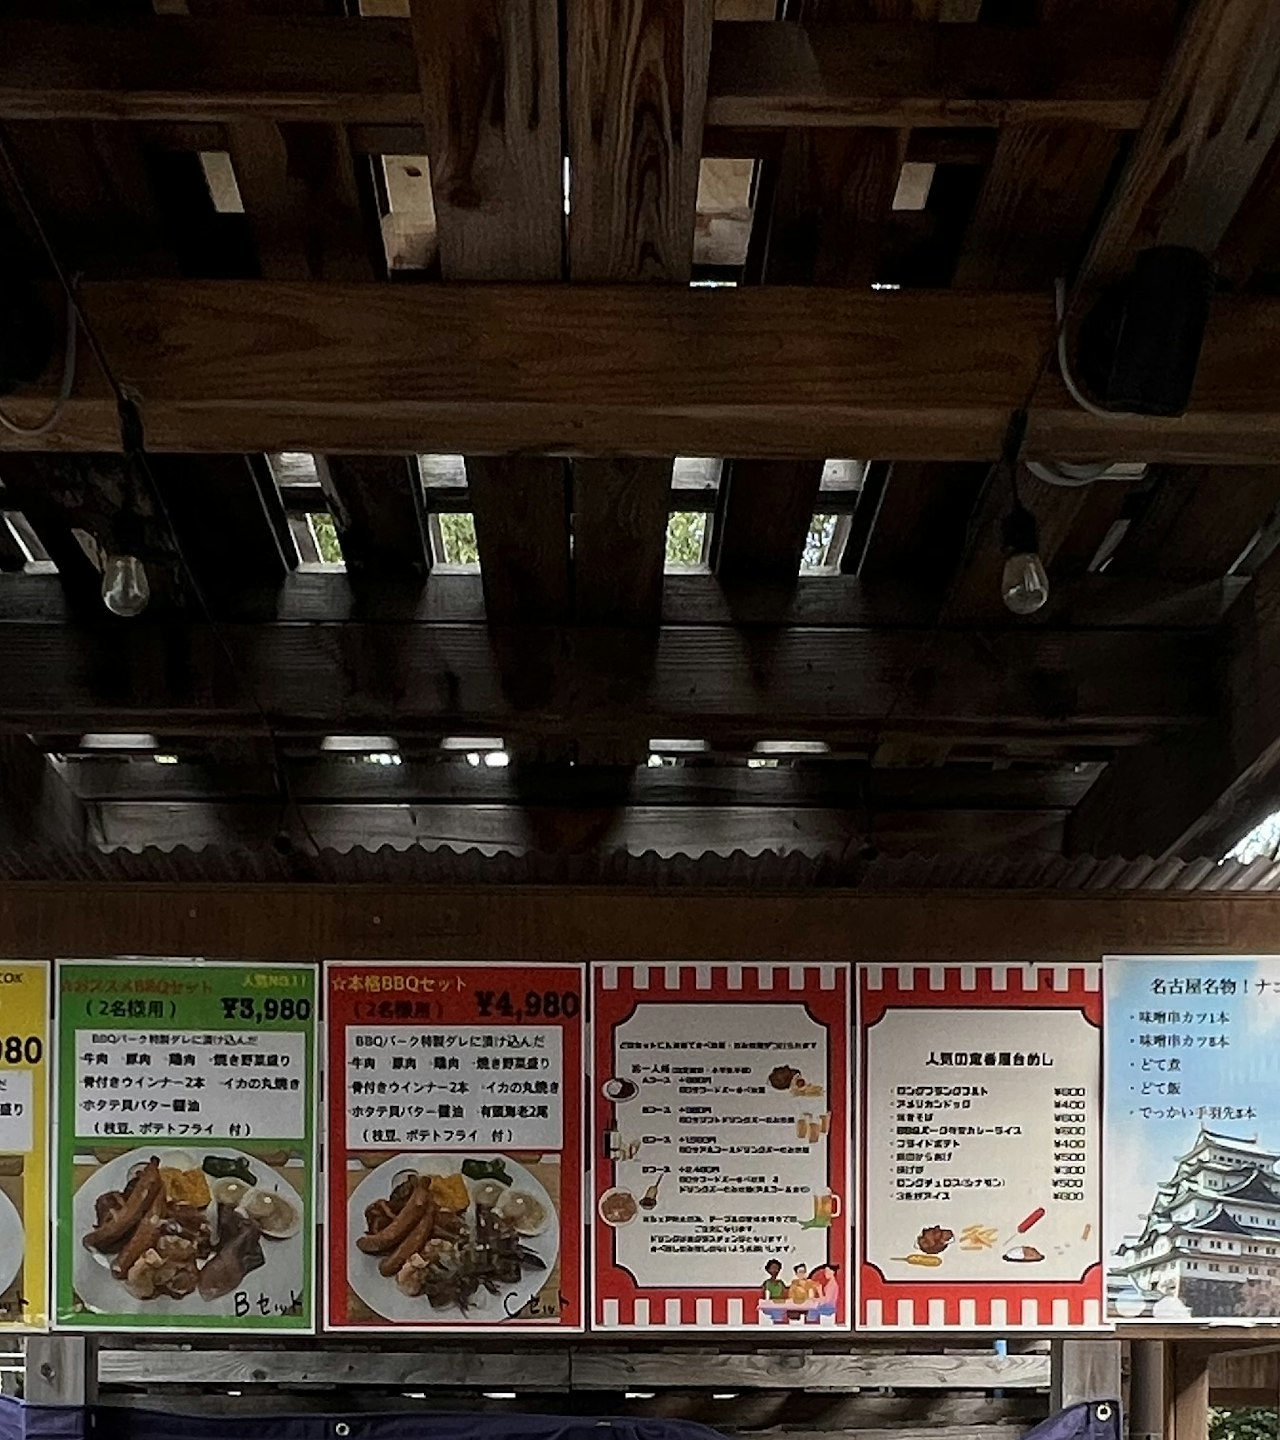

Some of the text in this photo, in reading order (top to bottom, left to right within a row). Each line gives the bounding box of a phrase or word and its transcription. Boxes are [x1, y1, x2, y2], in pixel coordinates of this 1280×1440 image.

[221, 997, 312, 1024] ¥3,980
[473, 990, 580, 1023] ¥4,980
[1141, 1057, 1182, 1072] どて煮
[1053, 1100, 1086, 1110] ¥400
[1053, 1139, 1086, 1149] ¥400
